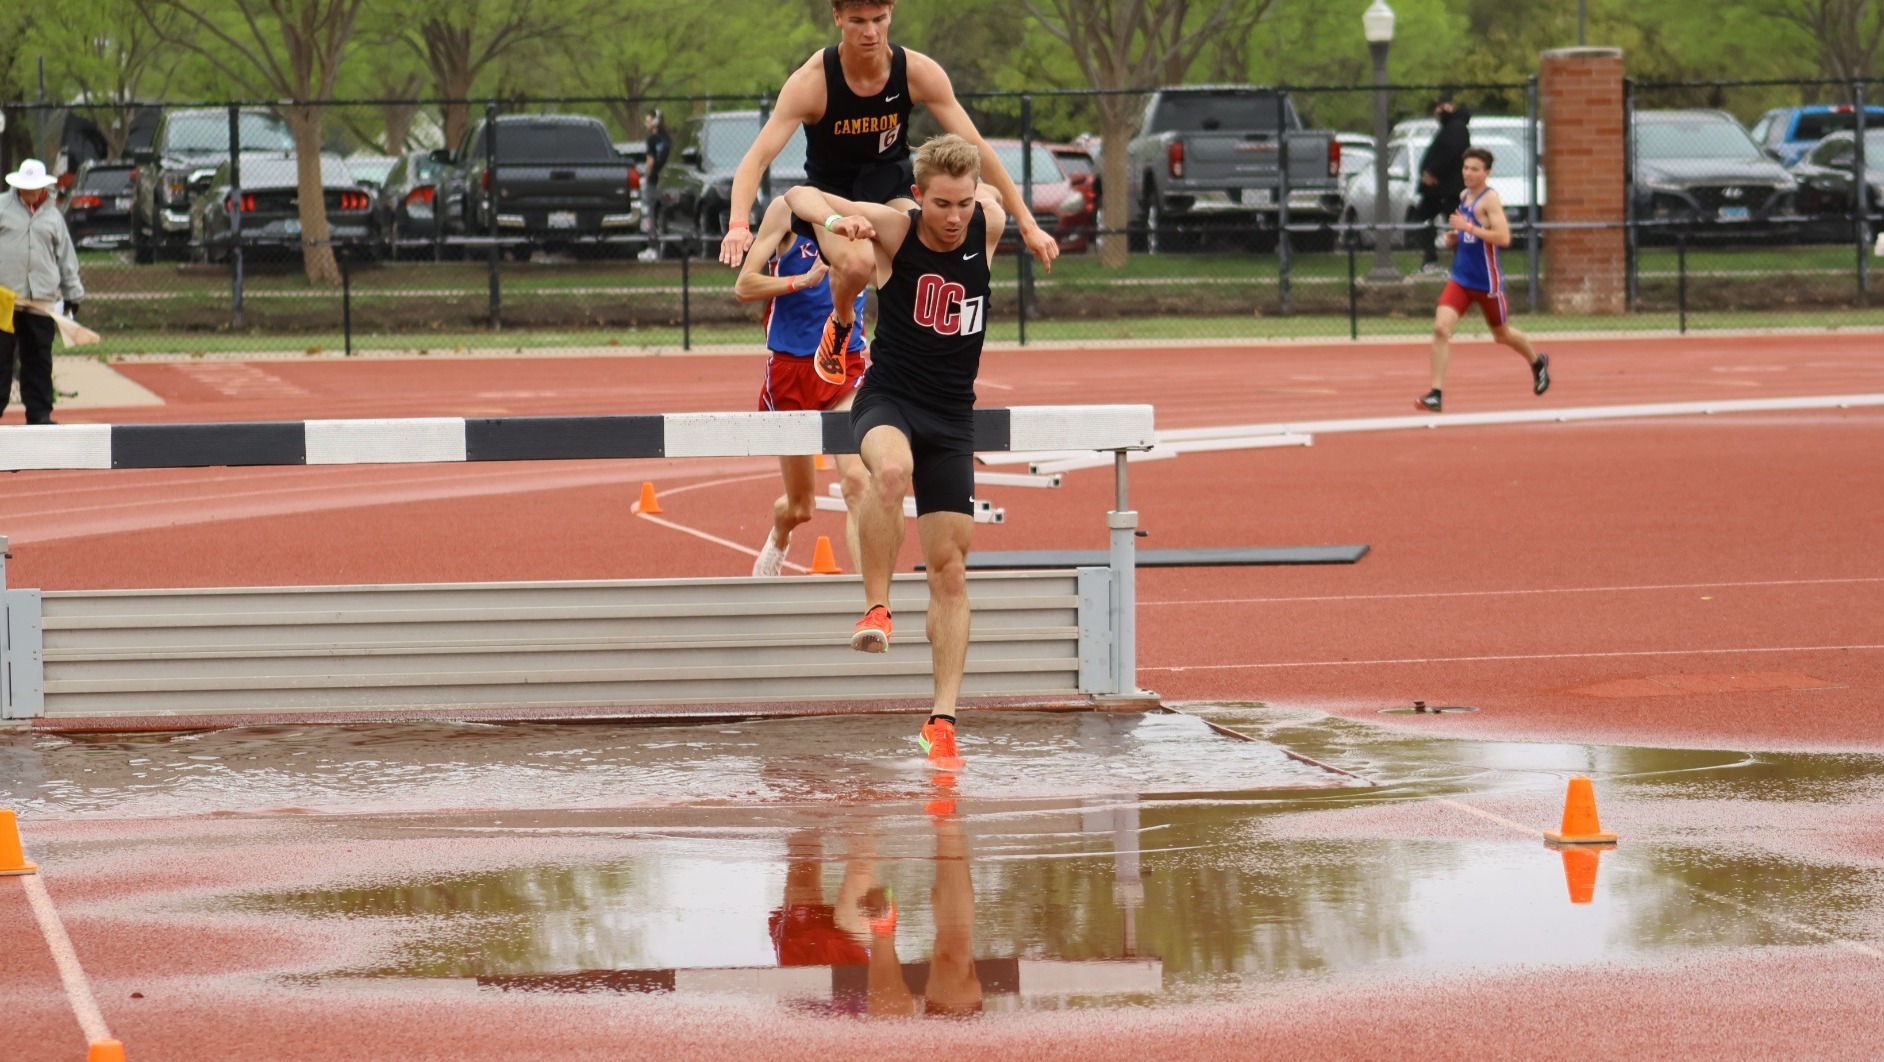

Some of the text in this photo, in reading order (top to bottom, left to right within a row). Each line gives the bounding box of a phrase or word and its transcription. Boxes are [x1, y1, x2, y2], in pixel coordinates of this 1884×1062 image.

[834, 113, 898, 135] CAMERON
[883, 127, 897, 147] 6
[914, 273, 965, 335] OC
[965, 299, 979, 333] 7
